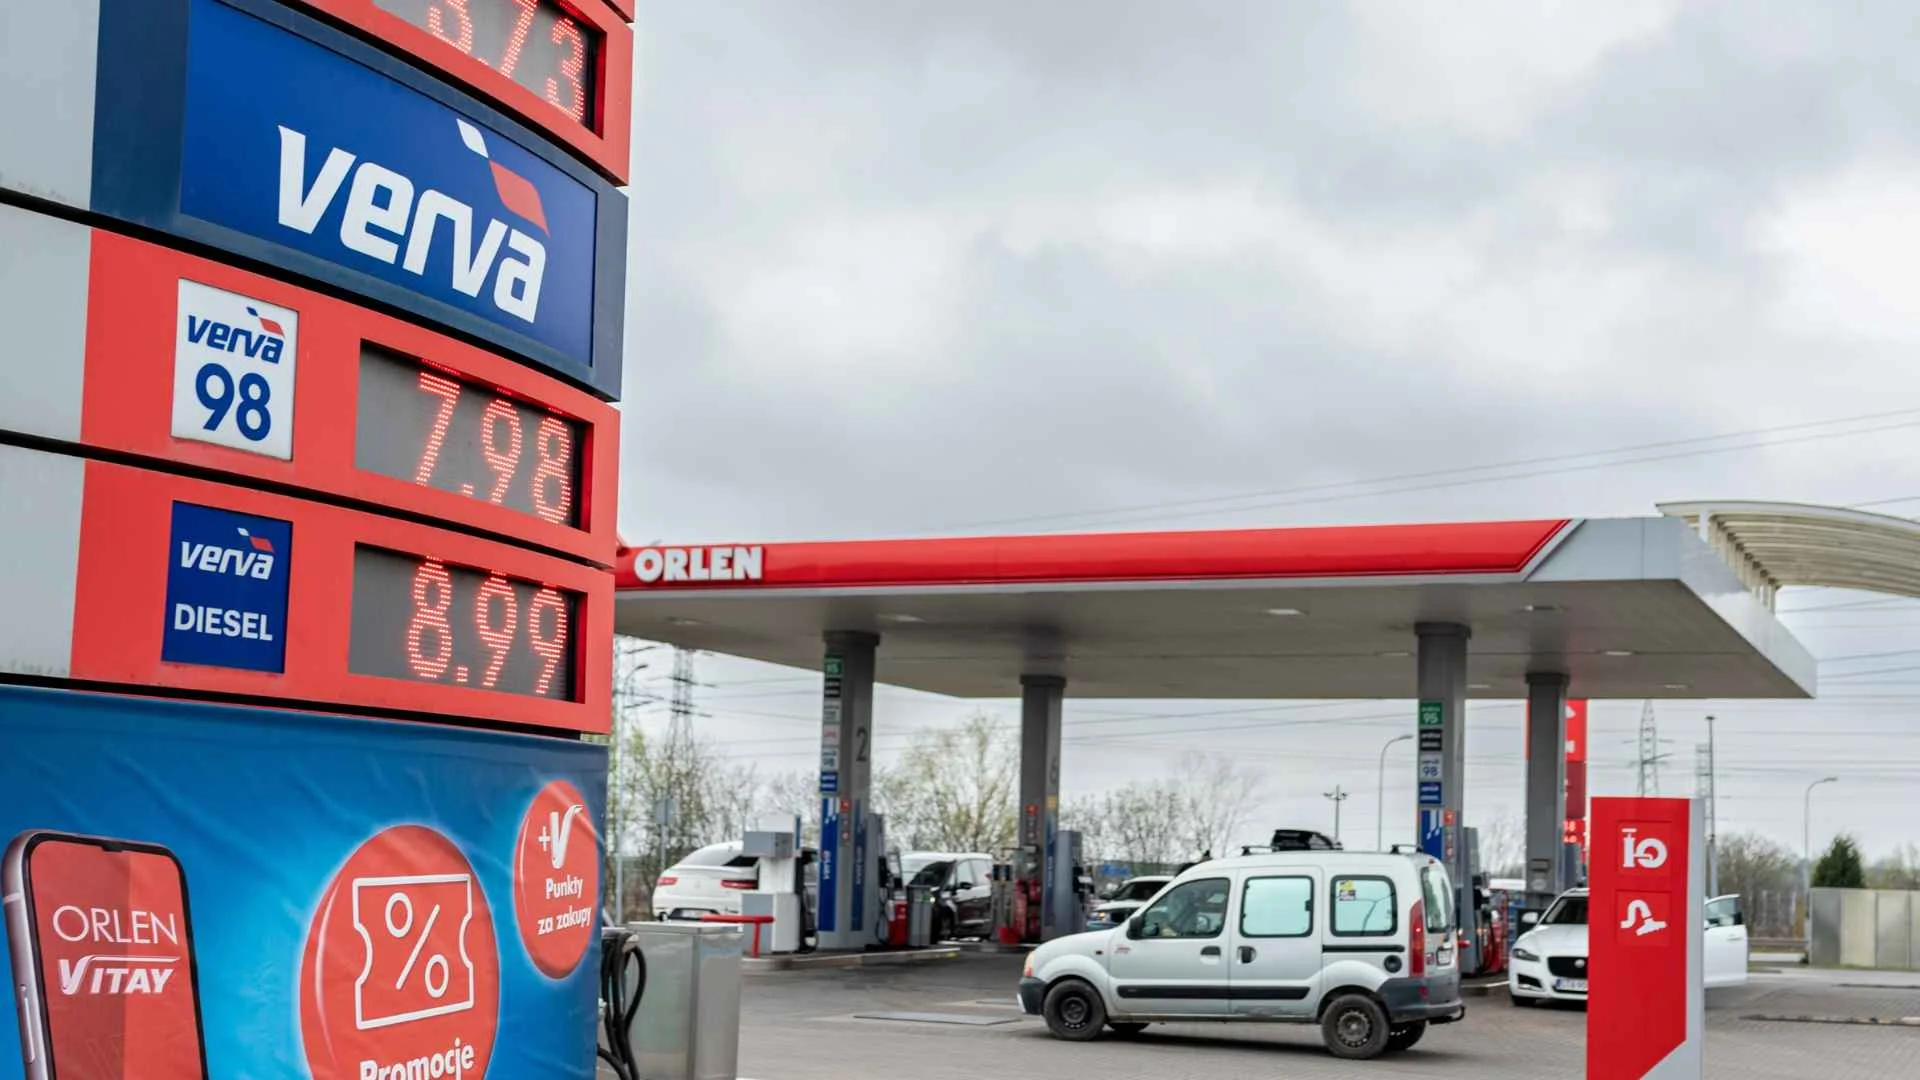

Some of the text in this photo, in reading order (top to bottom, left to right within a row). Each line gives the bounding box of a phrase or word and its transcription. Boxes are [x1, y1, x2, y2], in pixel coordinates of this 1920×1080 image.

[277, 123, 548, 324] verva
[187, 313, 285, 365] verva
[195, 362, 272, 442] 98
[415, 368, 573, 526] 7.98
[180, 539, 275, 581] verva
[633, 546, 763, 583] ORLEN
[173, 602, 274, 642] DIESEL
[408, 556, 568, 696] 8.99
[1423, 711, 1439, 724] 95
[856, 726, 867, 762] 2
[1422, 765, 1439, 778] 98
[545, 874, 584, 900] Punkty
[52, 904, 178, 945] ORLEN
[537, 905, 592, 936] za zakupy
[359, 1036, 476, 1080] Promocje
